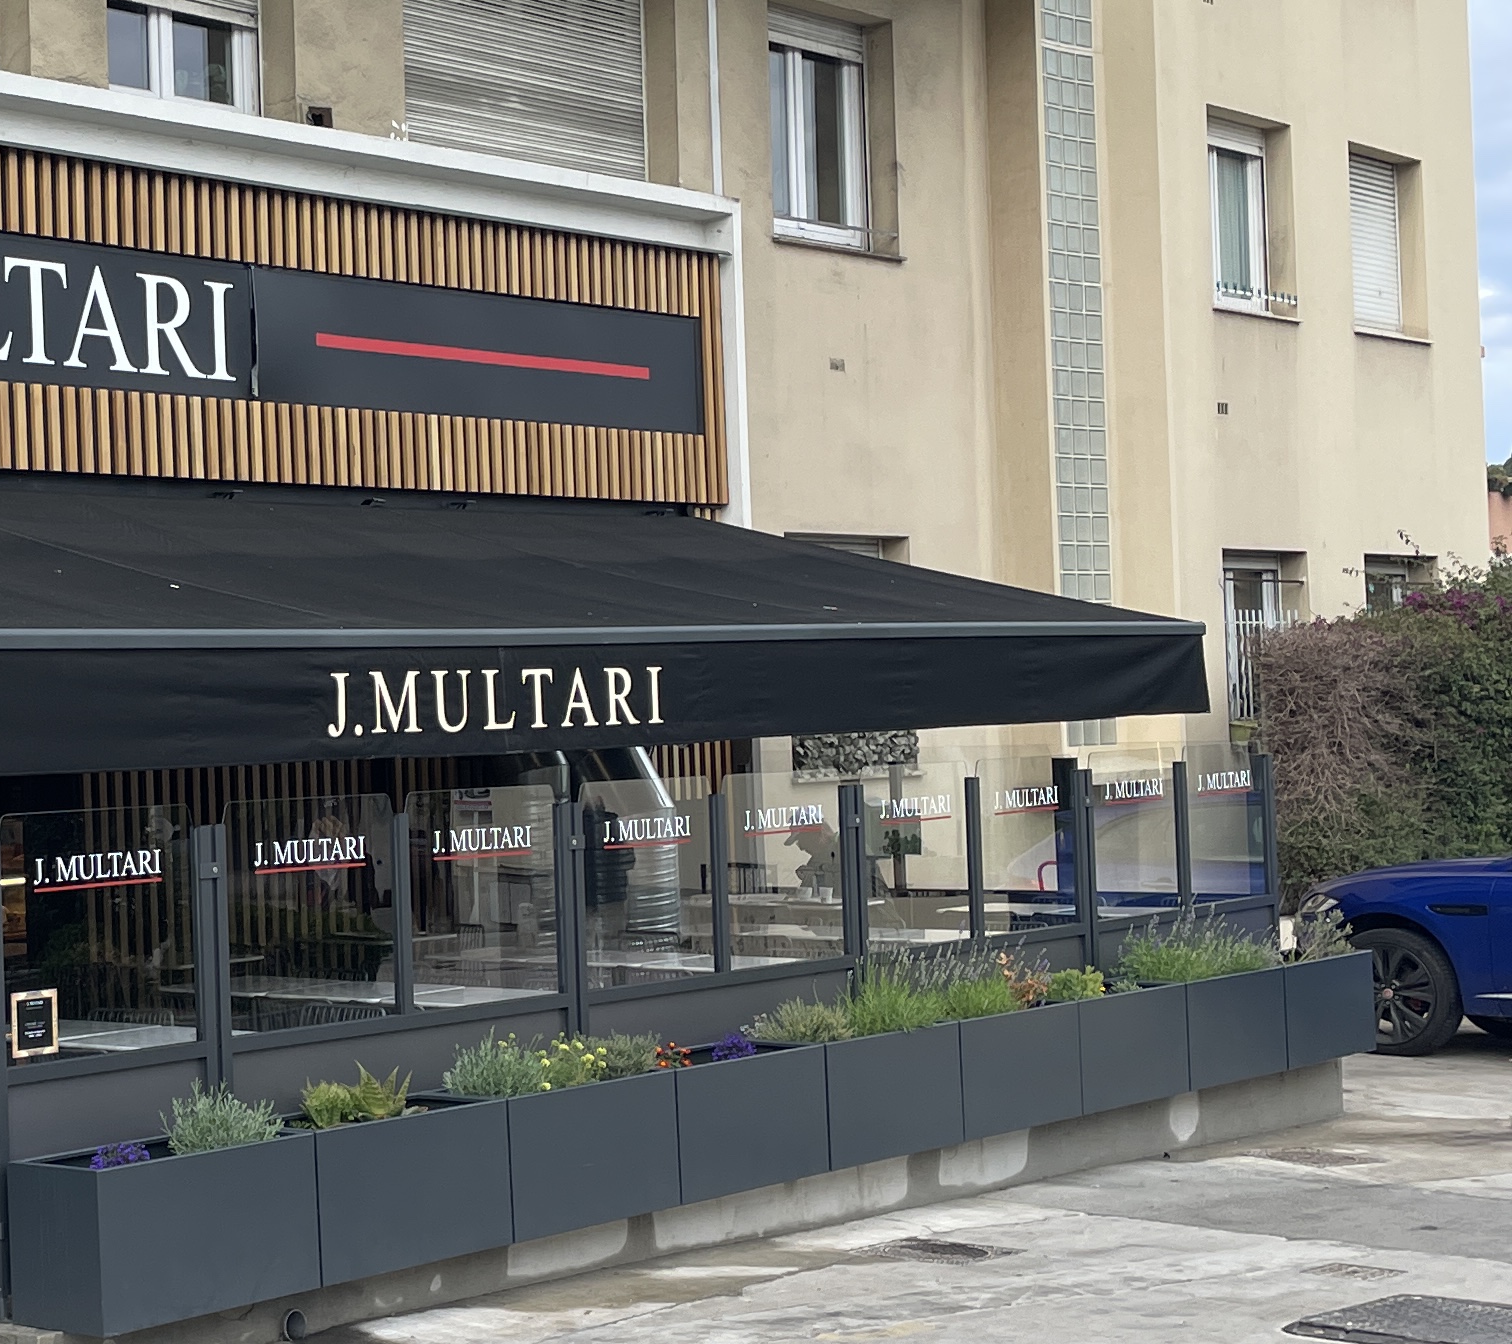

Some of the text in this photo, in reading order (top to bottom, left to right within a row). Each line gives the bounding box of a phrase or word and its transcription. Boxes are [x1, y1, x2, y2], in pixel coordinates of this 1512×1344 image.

[1114, 777, 1164, 800] MULTARI
[1206, 769, 1251, 790] MULTARI
[892, 793, 952, 818] MULTARI
[1005, 785, 1059, 809] MULTARI
[603, 815, 691, 844] J. MULTARI
[743, 804, 823, 832] J. MULTARI
[253, 835, 366, 867] J. MULTARI
[432, 825, 532, 854] J. MULTARI
[33, 849, 162, 886] J. MULTARI
